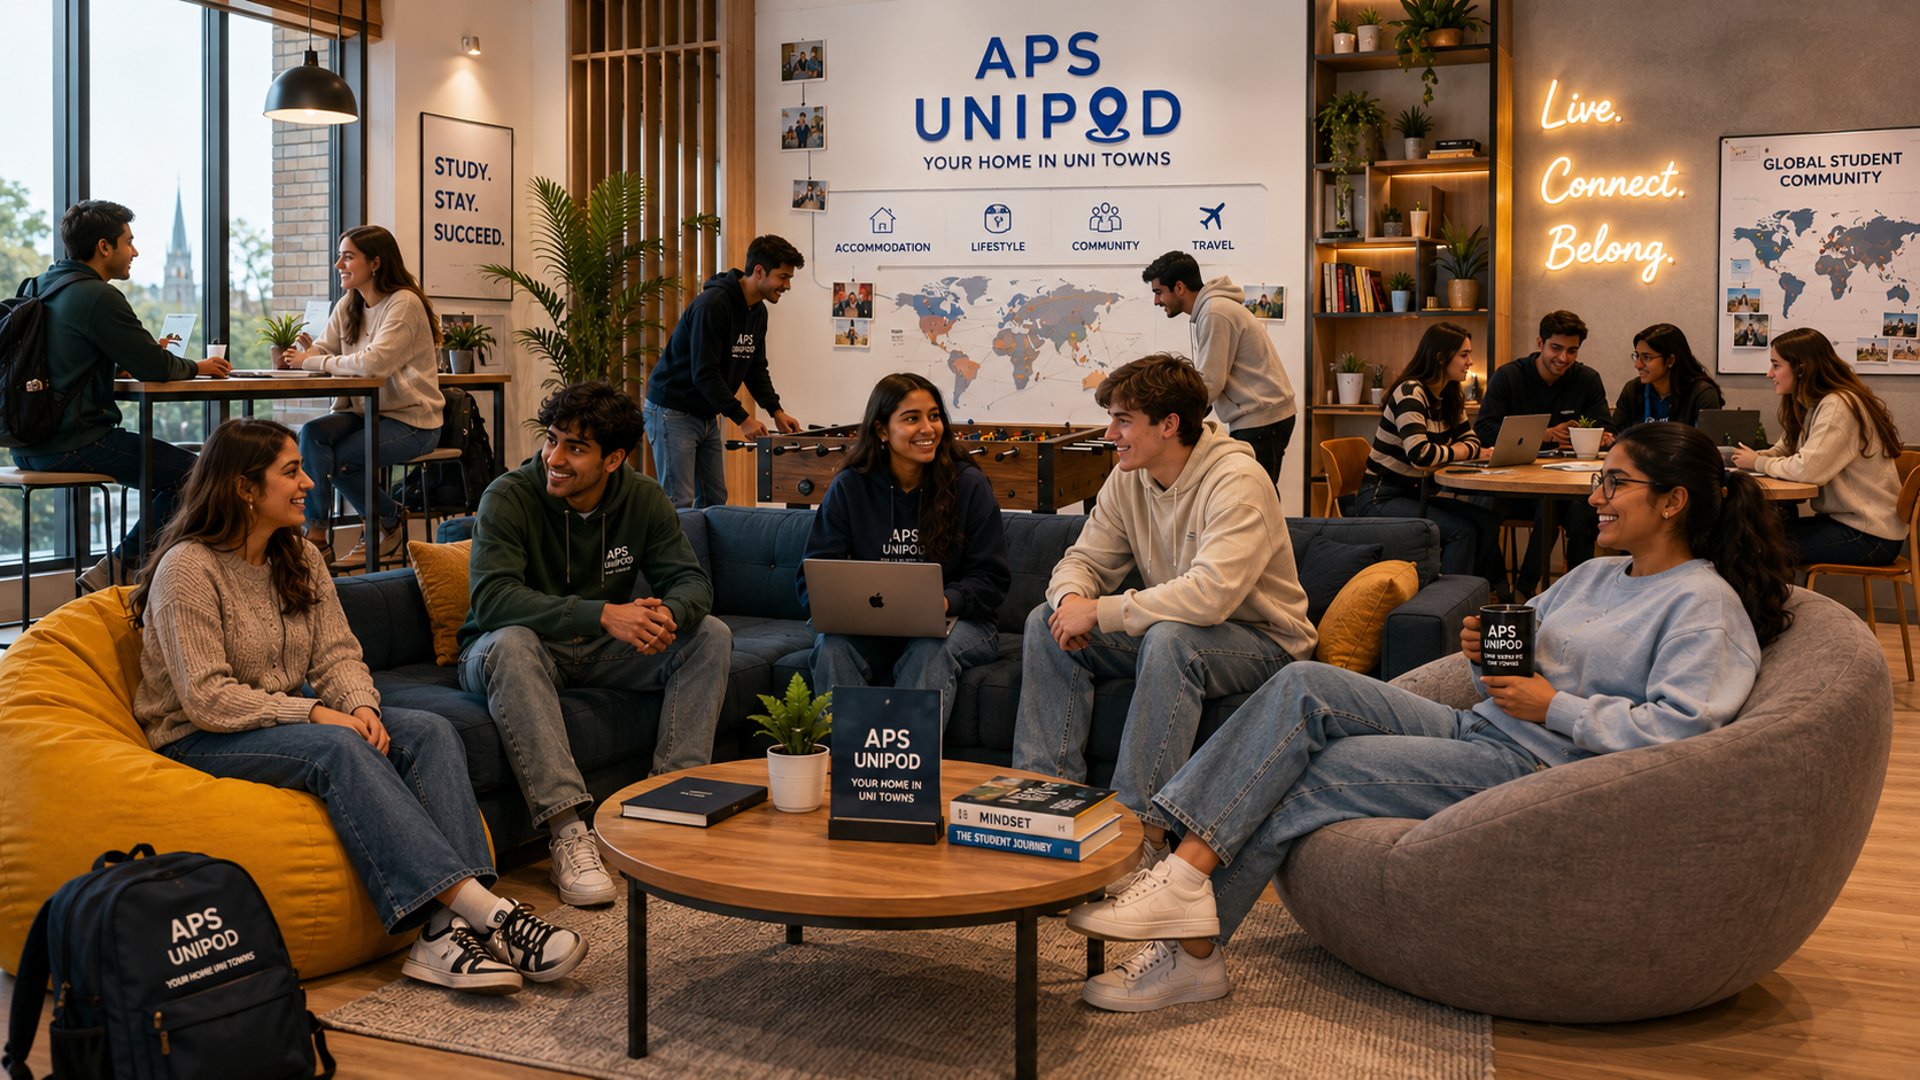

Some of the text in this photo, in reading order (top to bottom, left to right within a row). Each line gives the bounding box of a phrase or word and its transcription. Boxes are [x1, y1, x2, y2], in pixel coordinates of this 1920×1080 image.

[975, 31, 1101, 79] APS
[1541, 79, 1623, 130] Live.
[915, 86, 1182, 144] UNIPOD
[434, 156, 492, 181] STUDY.
[924, 151, 1171, 170] YOUR HOME IN UNI TOWNS
[1763, 151, 1903, 171] GLOBAL STUDENT
[1541, 156, 1686, 204] Connect.
[1780, 170, 1882, 187] COMMUNITY
[434, 190, 479, 212] STAY.
[434, 223, 505, 246] SUCCEED.
[835, 242, 931, 253] ACCOMMODATION
[971, 241, 1026, 252] LIFESTYLE
[1072, 240, 1140, 251] COMMUNITY
[1192, 240, 1235, 250] TRAVEL
[1545, 223, 1676, 283] Belong.
[736, 333, 753, 345] APS
[889, 528, 919, 543] APS
[606, 545, 629, 560] APS
[882, 544, 925, 555] UNIPOD
[1487, 624, 1517, 638] APS
[1484, 639, 1523, 650] UNIPOD
[864, 728, 911, 749] APS
[854, 752, 921, 770] UNIPOD
[851, 778, 922, 790] YOUR HOME IN
[858, 791, 915, 803] UNI TOWNS
[979, 811, 1032, 829] MINDSET
[956, 830, 972, 841] THE
[974, 833, 1011, 847] STUDENT
[171, 907, 223, 944] APS
[167, 929, 239, 966] UNIPOD
